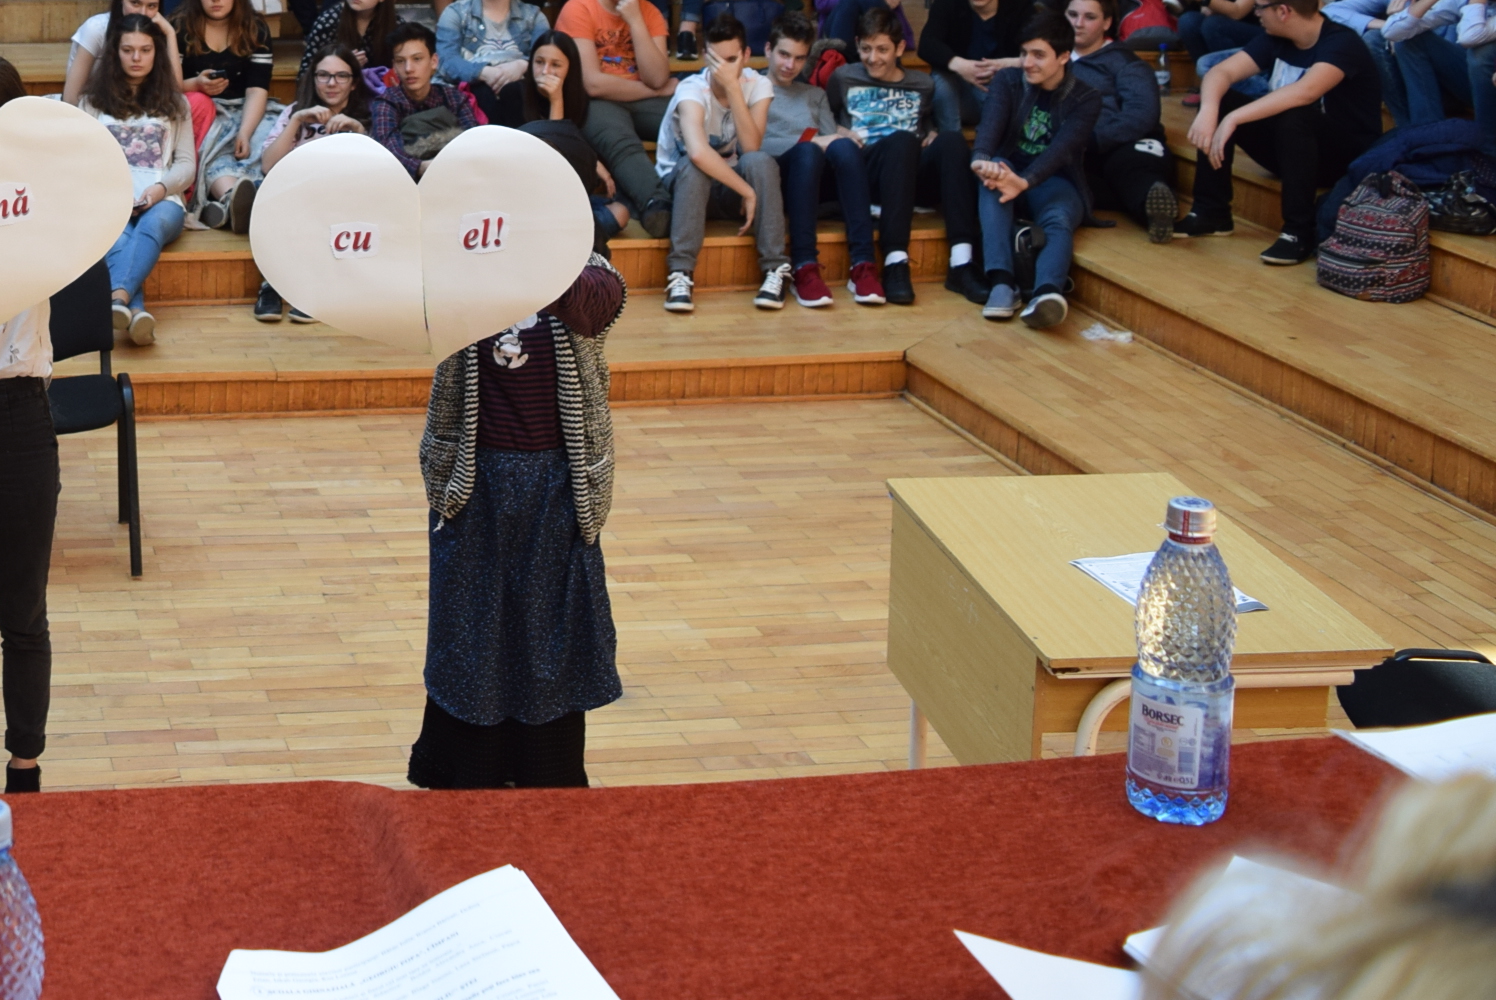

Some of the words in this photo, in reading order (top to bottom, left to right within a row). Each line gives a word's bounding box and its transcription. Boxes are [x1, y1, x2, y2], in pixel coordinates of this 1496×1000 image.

[334, 230, 372, 252] cu
[463, 216, 504, 251] el!
[1141, 703, 1184, 726] BORSEC
